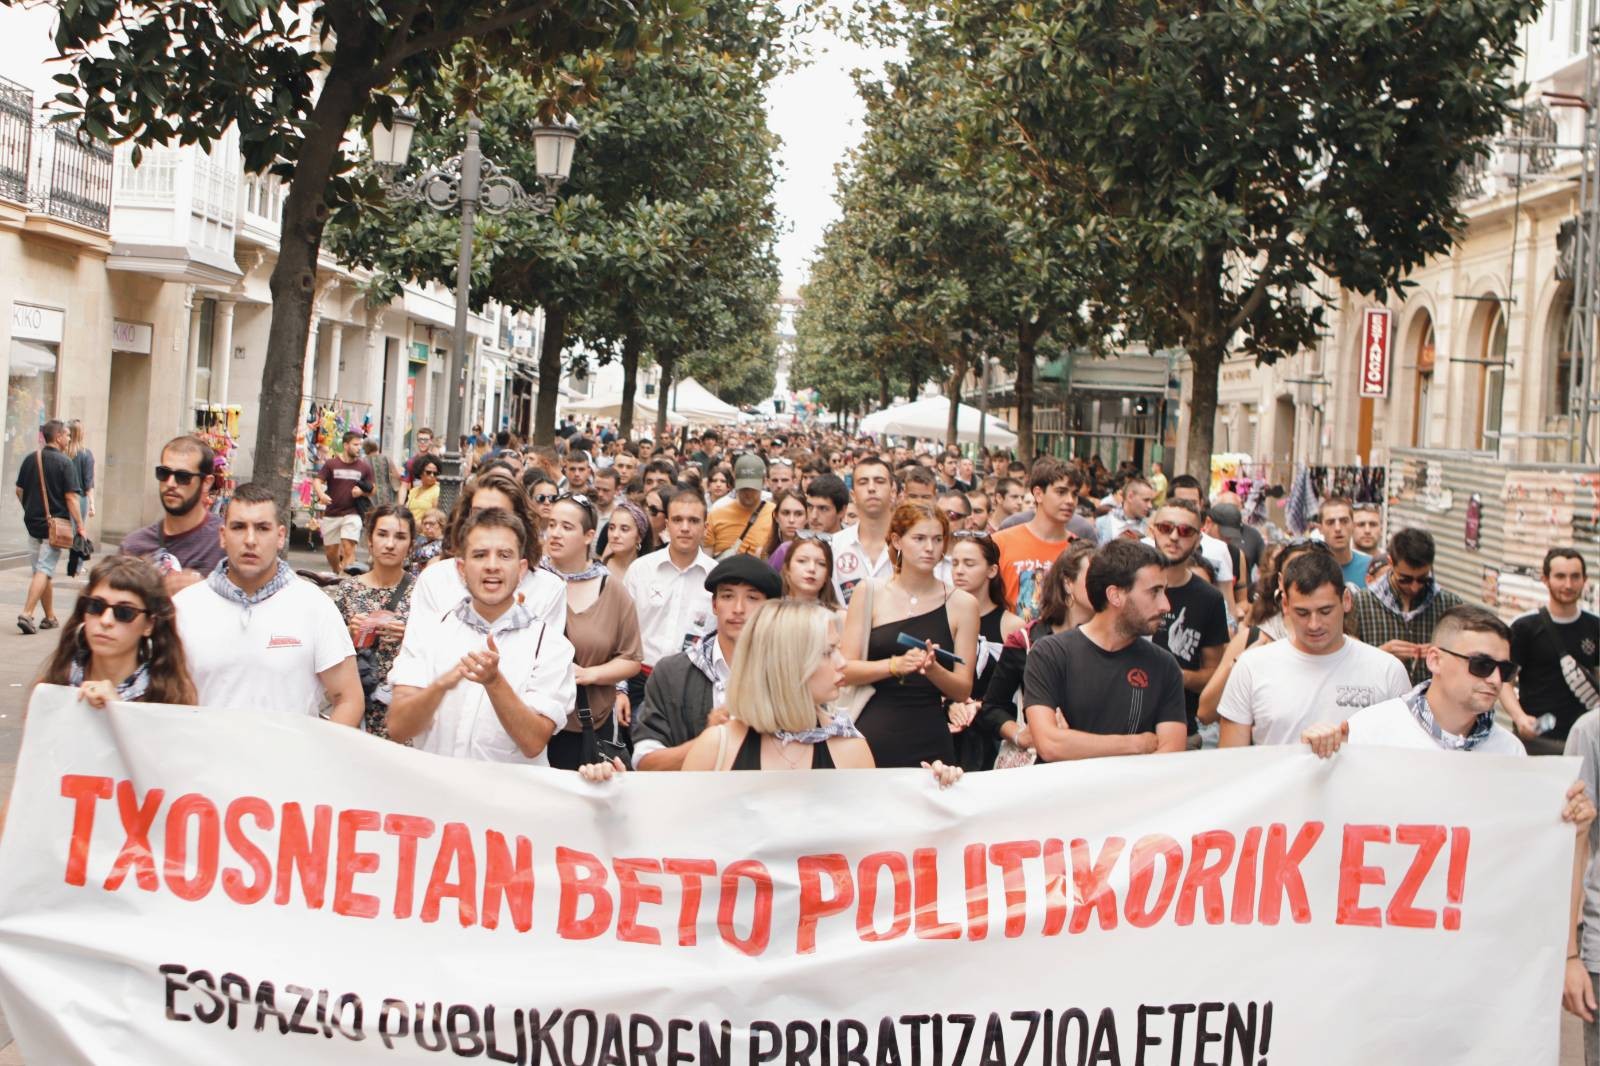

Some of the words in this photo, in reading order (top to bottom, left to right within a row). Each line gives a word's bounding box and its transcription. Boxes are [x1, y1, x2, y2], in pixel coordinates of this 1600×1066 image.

[13, 307, 42, 330] KIKO
[113, 324, 136, 343] KIKO
[60, 773, 536, 934] TXOSNETAN
[555, 845, 774, 957] BETO
[796, 820, 1325, 955] POLITIKORIK
[1335, 825, 1471, 932] EZ!
[158, 963, 364, 1041] ESPAZIO
[378, 998, 733, 1066] PUBLIKOAREN
[749, 1006, 1121, 1066] PRIBATIZAZIOA
[1134, 1001, 1273, 1066] ETEN!
